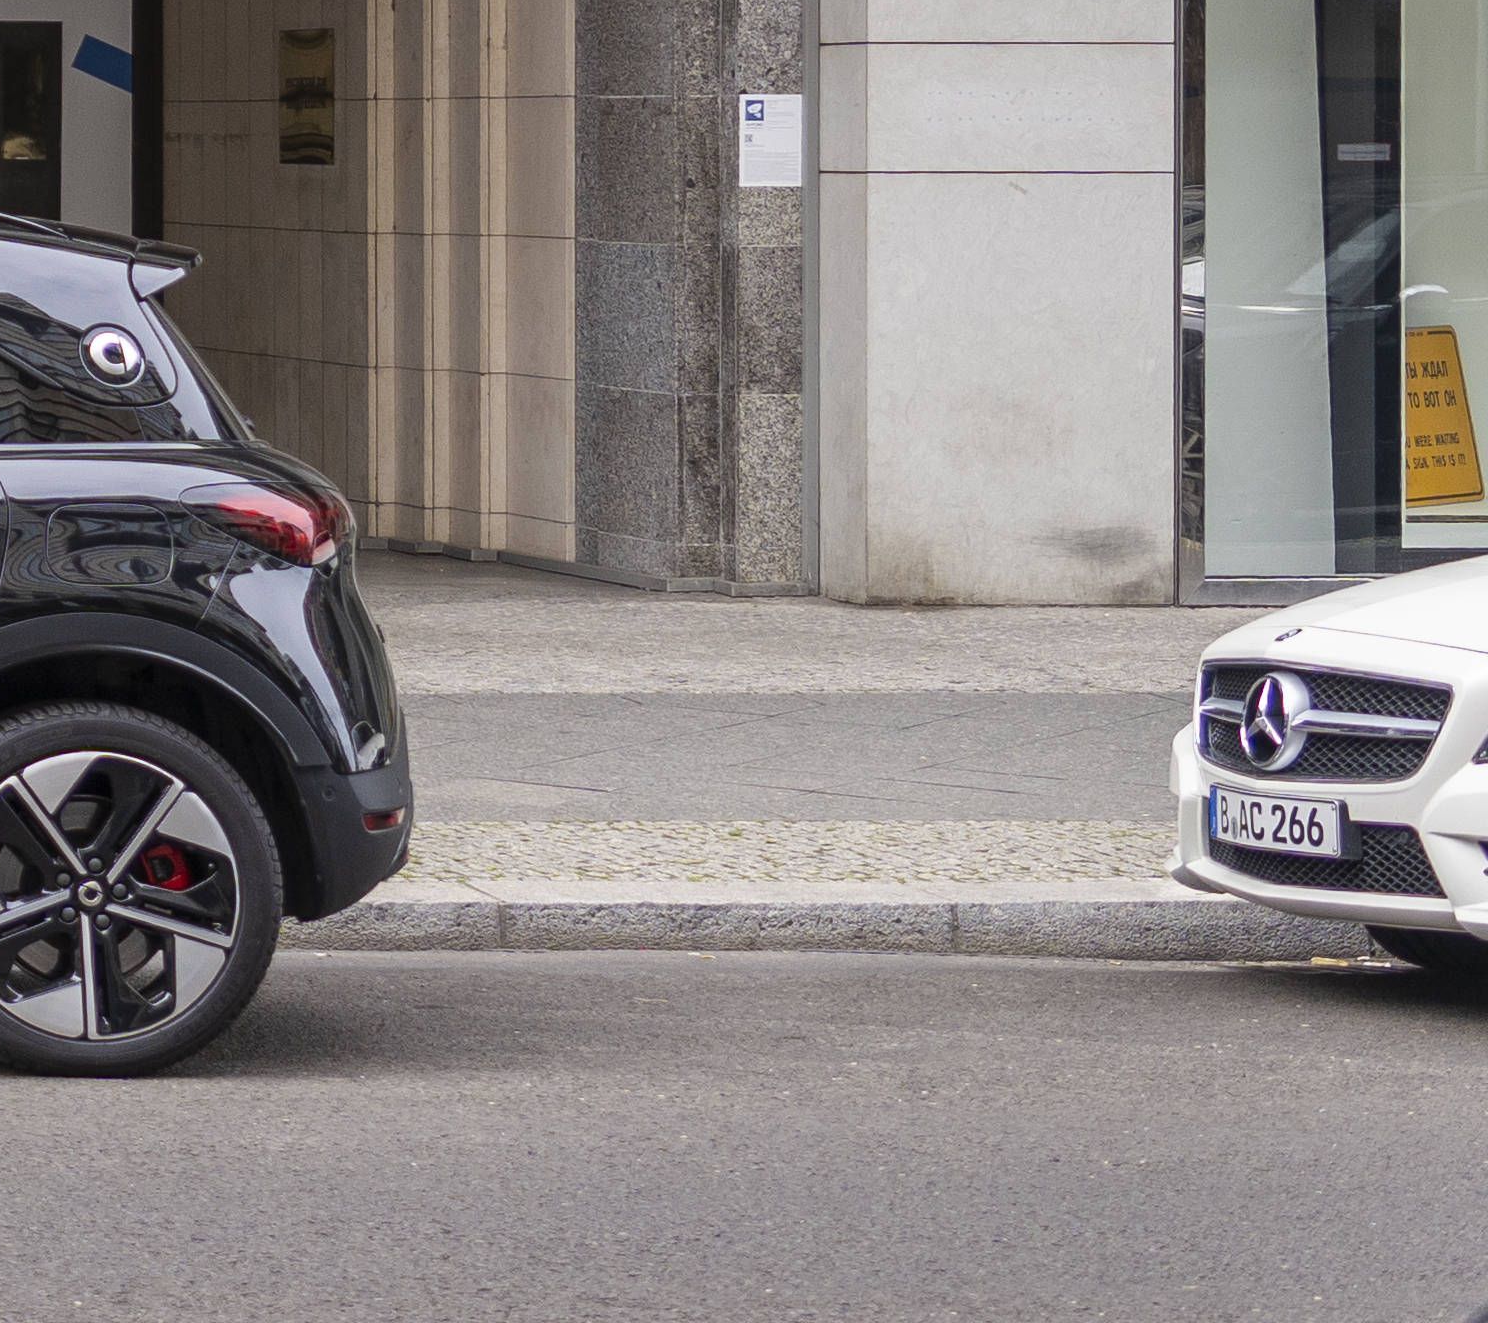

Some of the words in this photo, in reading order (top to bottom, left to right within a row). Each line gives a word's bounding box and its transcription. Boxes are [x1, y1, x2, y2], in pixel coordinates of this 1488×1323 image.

[1421, 360, 1449, 379] ЖДАЛ
[1407, 391, 1420, 408] ТО
[1424, 390, 1440, 408] ВОТ
[1444, 389, 1457, 407] ОН
[1220, 795, 1229, 834] B
[1239, 799, 1265, 841] AC
[1271, 803, 1324, 847] 266
